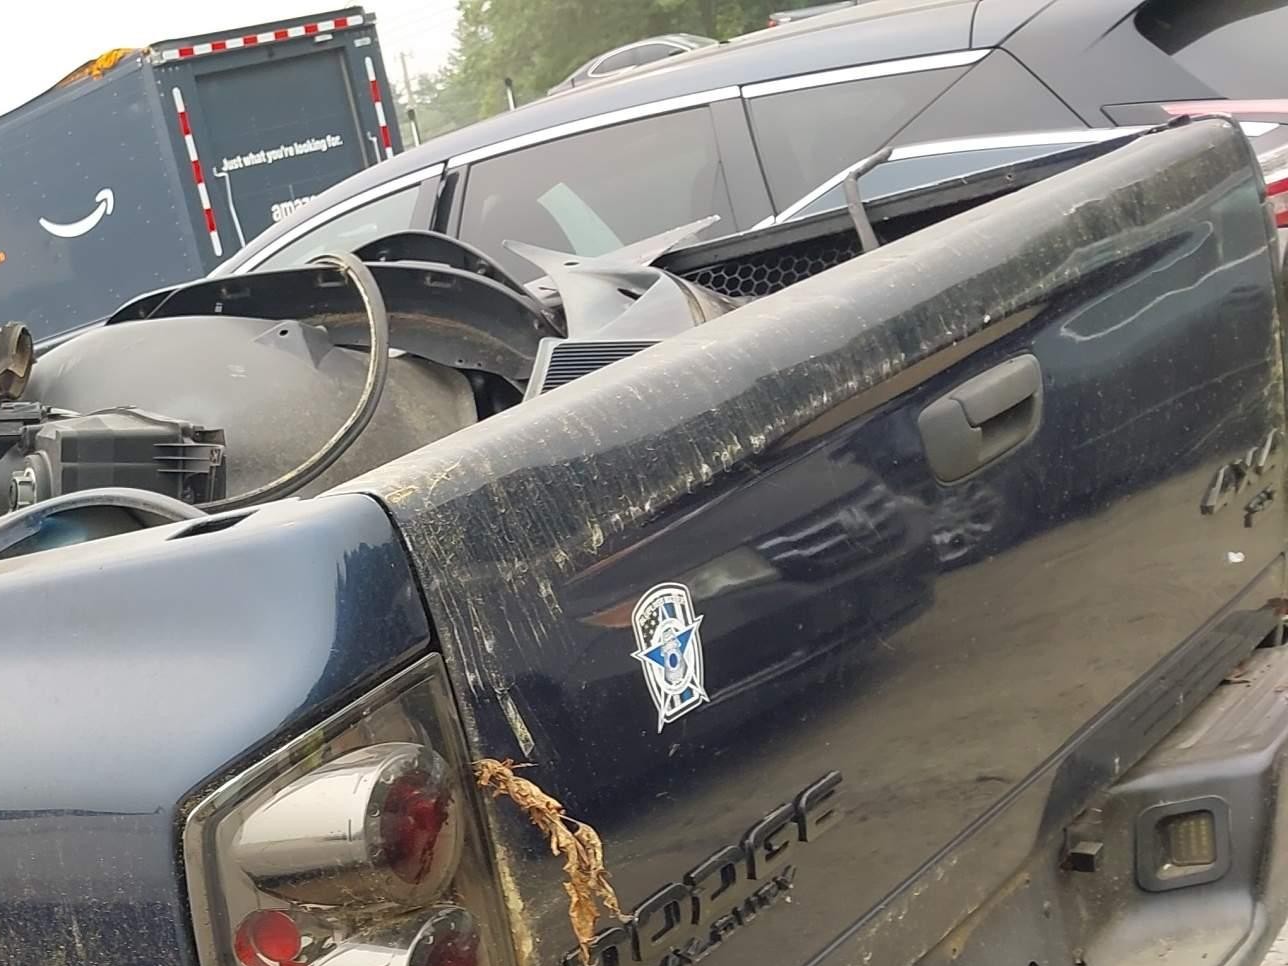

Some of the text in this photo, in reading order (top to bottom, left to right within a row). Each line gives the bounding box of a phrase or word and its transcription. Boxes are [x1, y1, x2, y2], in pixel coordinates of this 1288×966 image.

[222, 134, 344, 171] Just what you're looking for.
